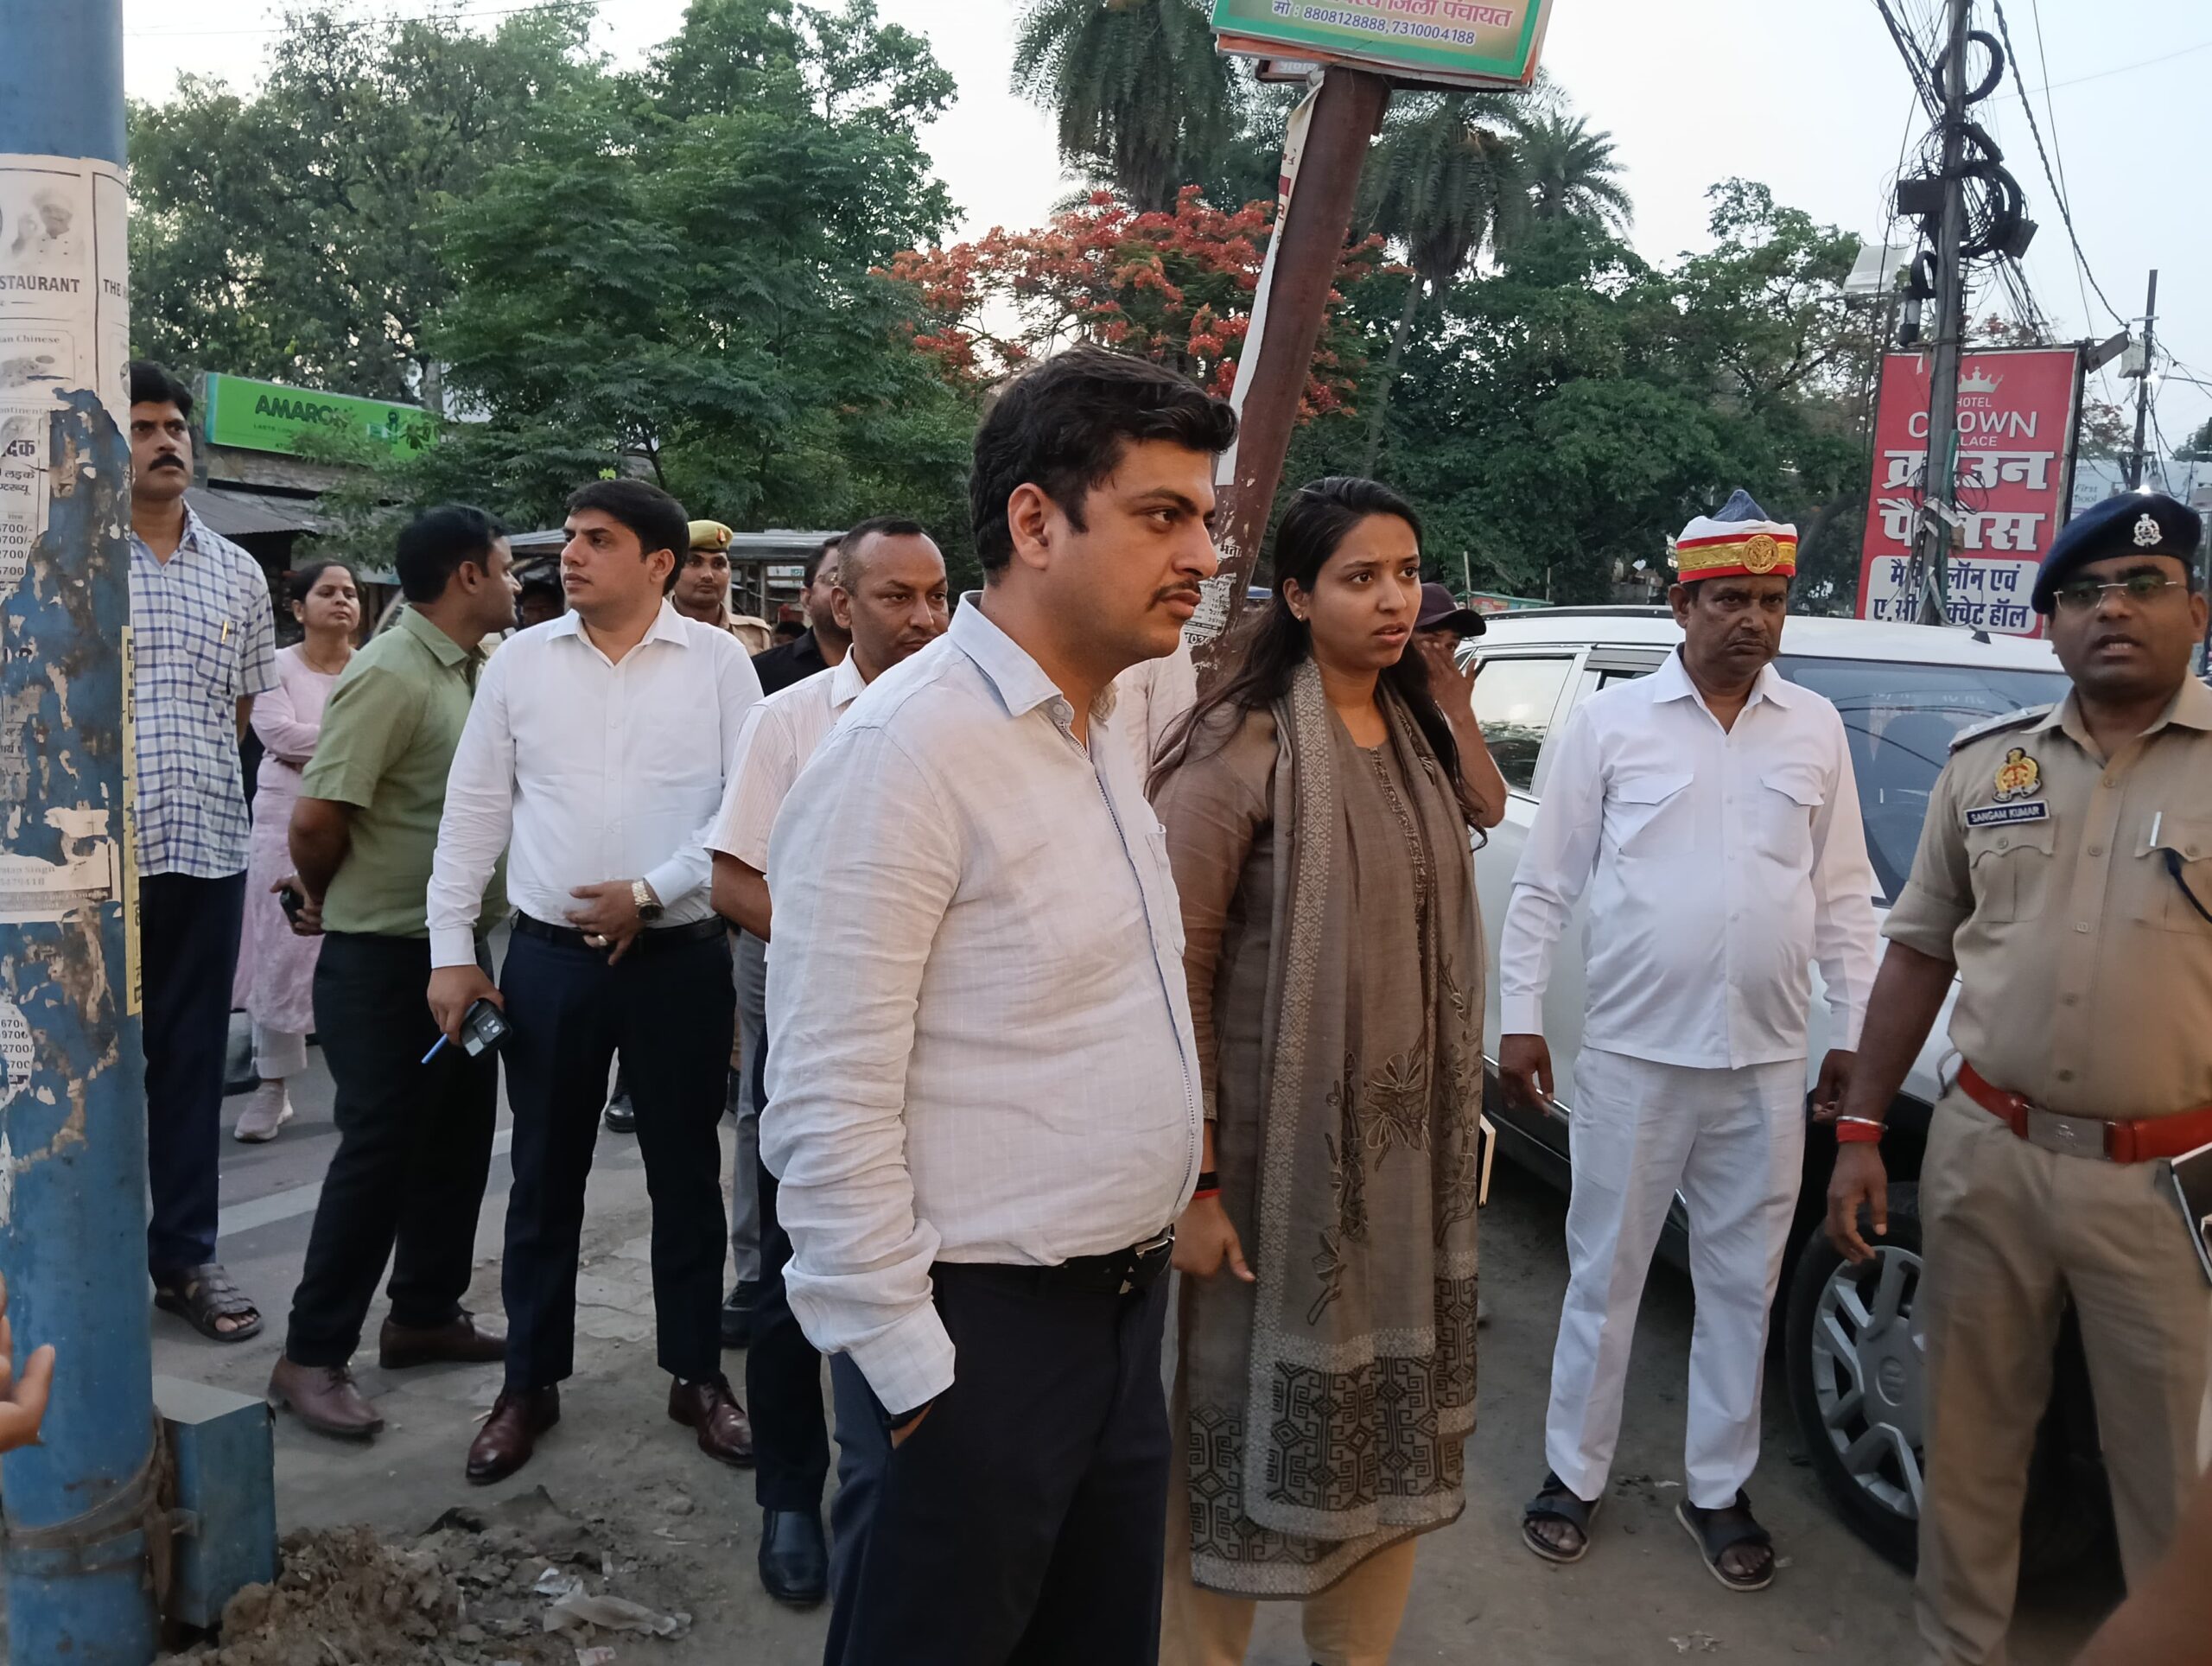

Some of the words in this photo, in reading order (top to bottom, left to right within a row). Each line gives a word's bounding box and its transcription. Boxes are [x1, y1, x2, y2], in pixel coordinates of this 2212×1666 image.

[1442, 0, 1514, 27] पंचायत
[0, 275, 80, 293] STAURANT
[103, 278, 121, 297] THE
[16, 334, 60, 344] Chinese
[1908, 410, 2037, 438] COWN
[1956, 436, 1998, 447] LACE
[1990, 563, 2021, 592] एवं
[1989, 598, 2030, 628] हॉल
[1970, 809, 2007, 823] SANGAM
[2008, 805, 2040, 818] KUMAR
